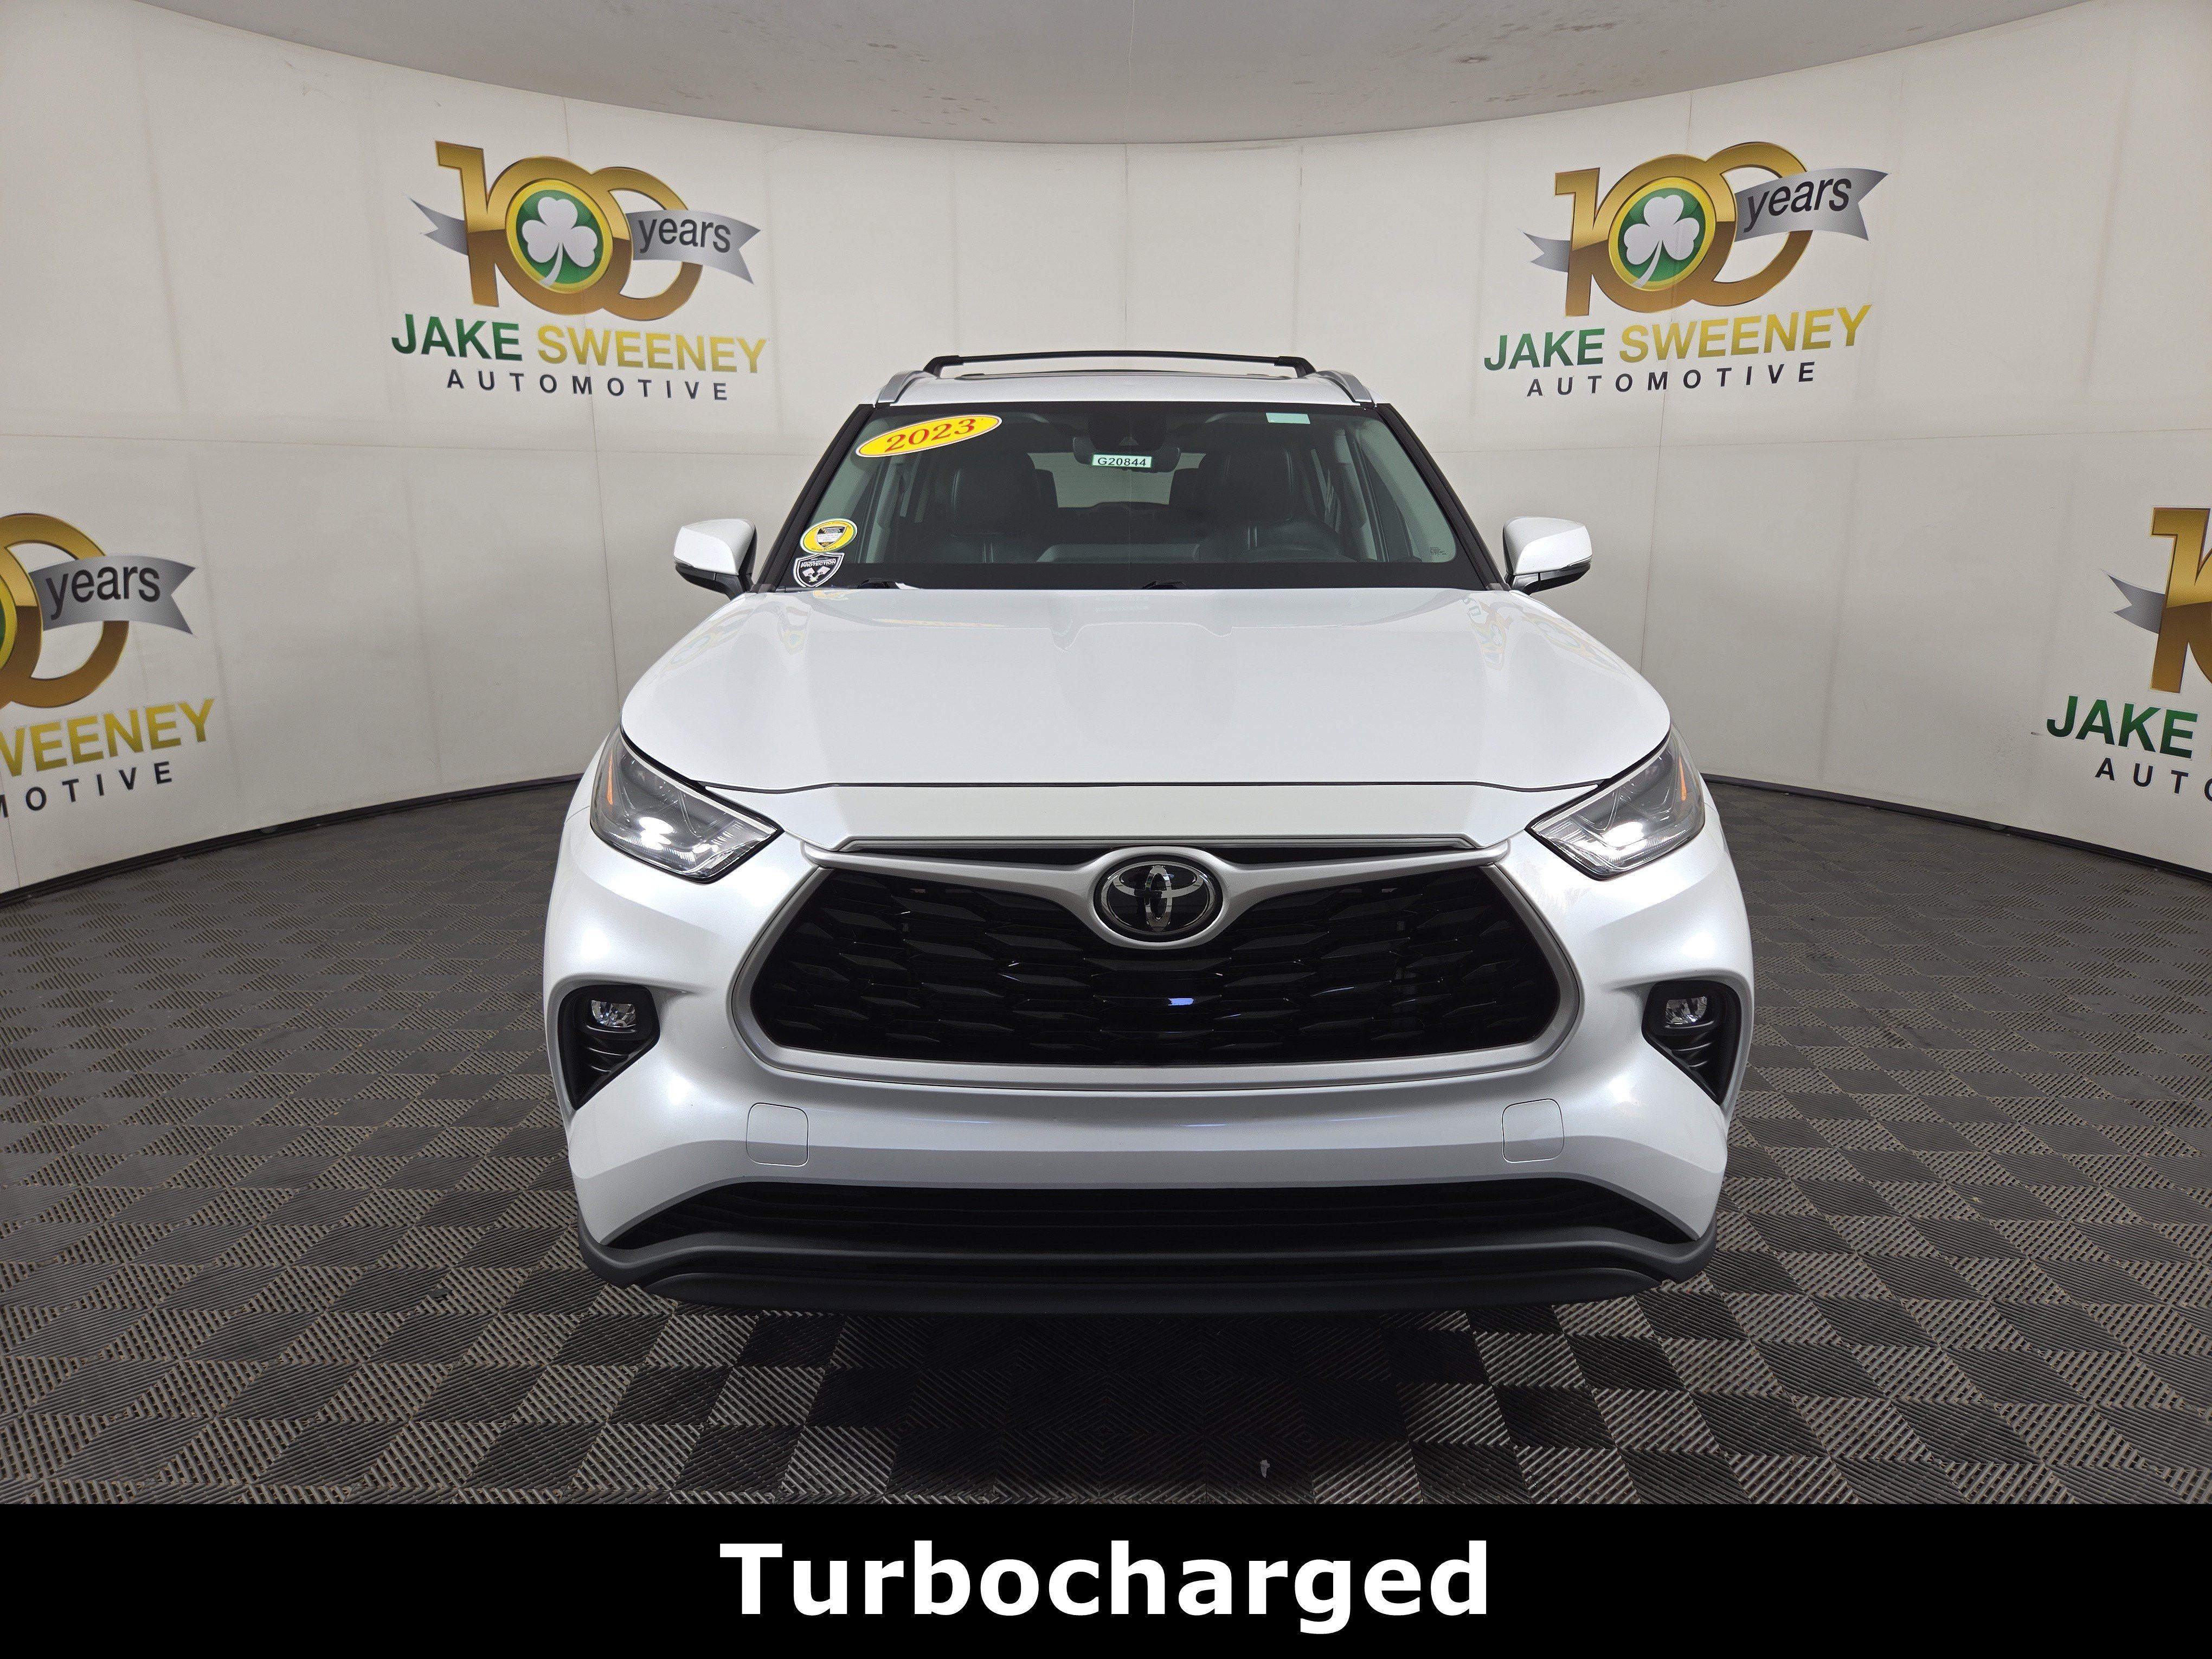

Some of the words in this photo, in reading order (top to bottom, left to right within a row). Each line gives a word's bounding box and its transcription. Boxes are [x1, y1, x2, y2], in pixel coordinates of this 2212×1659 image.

[1742, 177, 1852, 233] years
[639, 216, 731, 253] years
[391, 314, 524, 362] JAKE
[537, 325, 767, 374] SWEENEY
[1484, 328, 1605, 371] JAKE
[1619, 304, 1873, 363] SWEENEY
[447, 369, 728, 400] AUTOMOTIVE
[1526, 362, 1815, 397] AUTOMOTIVE
[884, 419, 976, 452] 2023
[1097, 457, 1146, 467] G20844
[46, 565, 161, 620] years
[2047, 695, 2198, 759] JAKE
